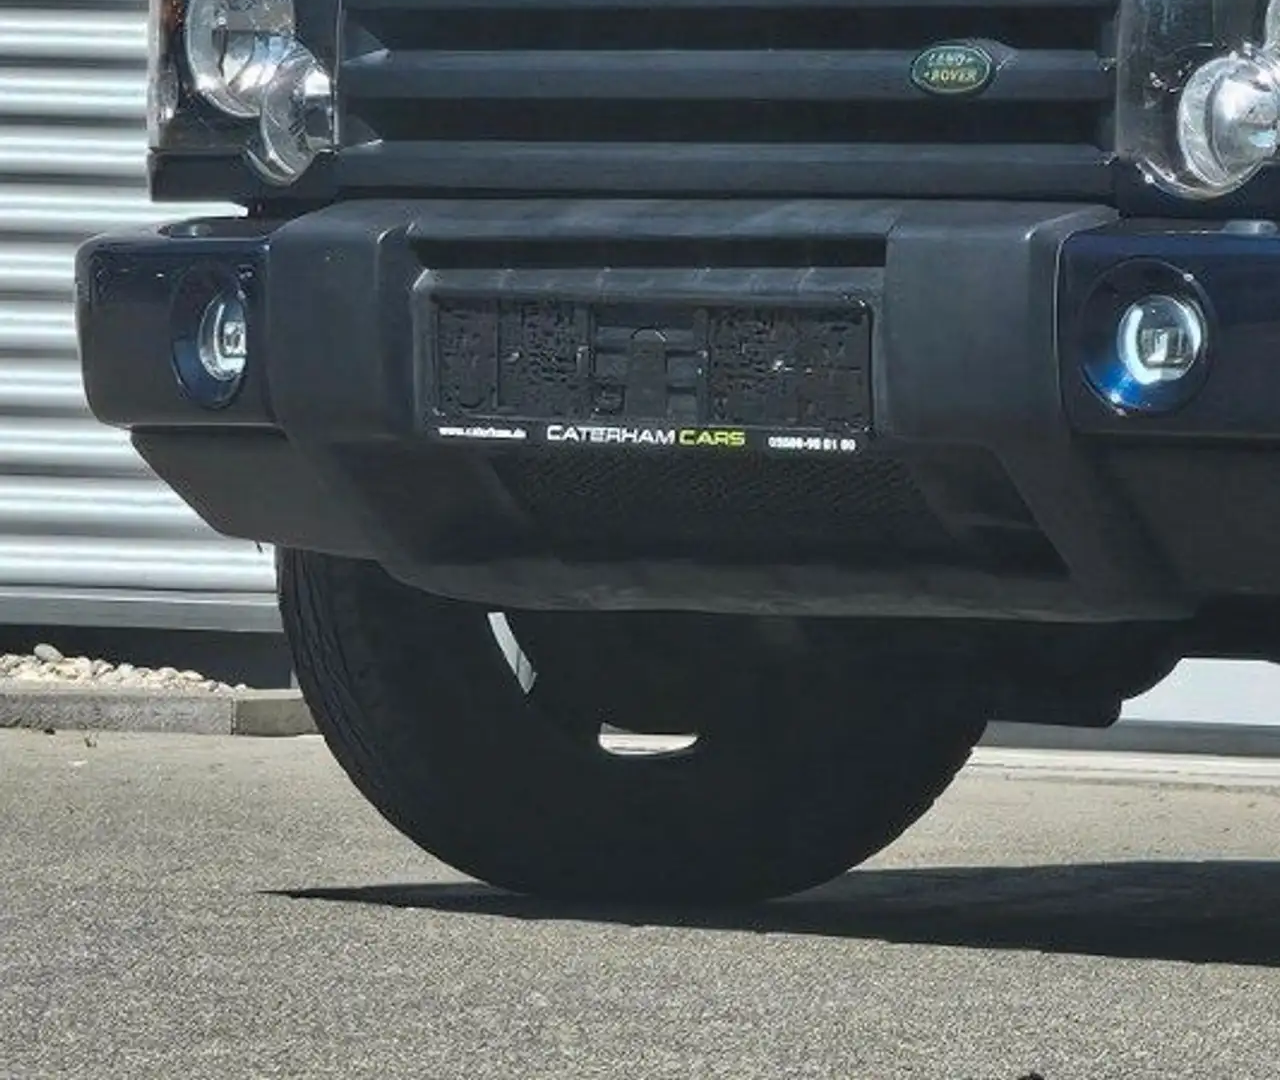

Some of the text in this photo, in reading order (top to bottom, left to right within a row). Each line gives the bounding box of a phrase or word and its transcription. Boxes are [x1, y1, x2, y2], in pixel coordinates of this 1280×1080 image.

[928, 53, 966, 67] LAND
[931, 68, 978, 81] ROVER
[547, 424, 676, 444] CATERHAM
[679, 429, 745, 445] CARS
